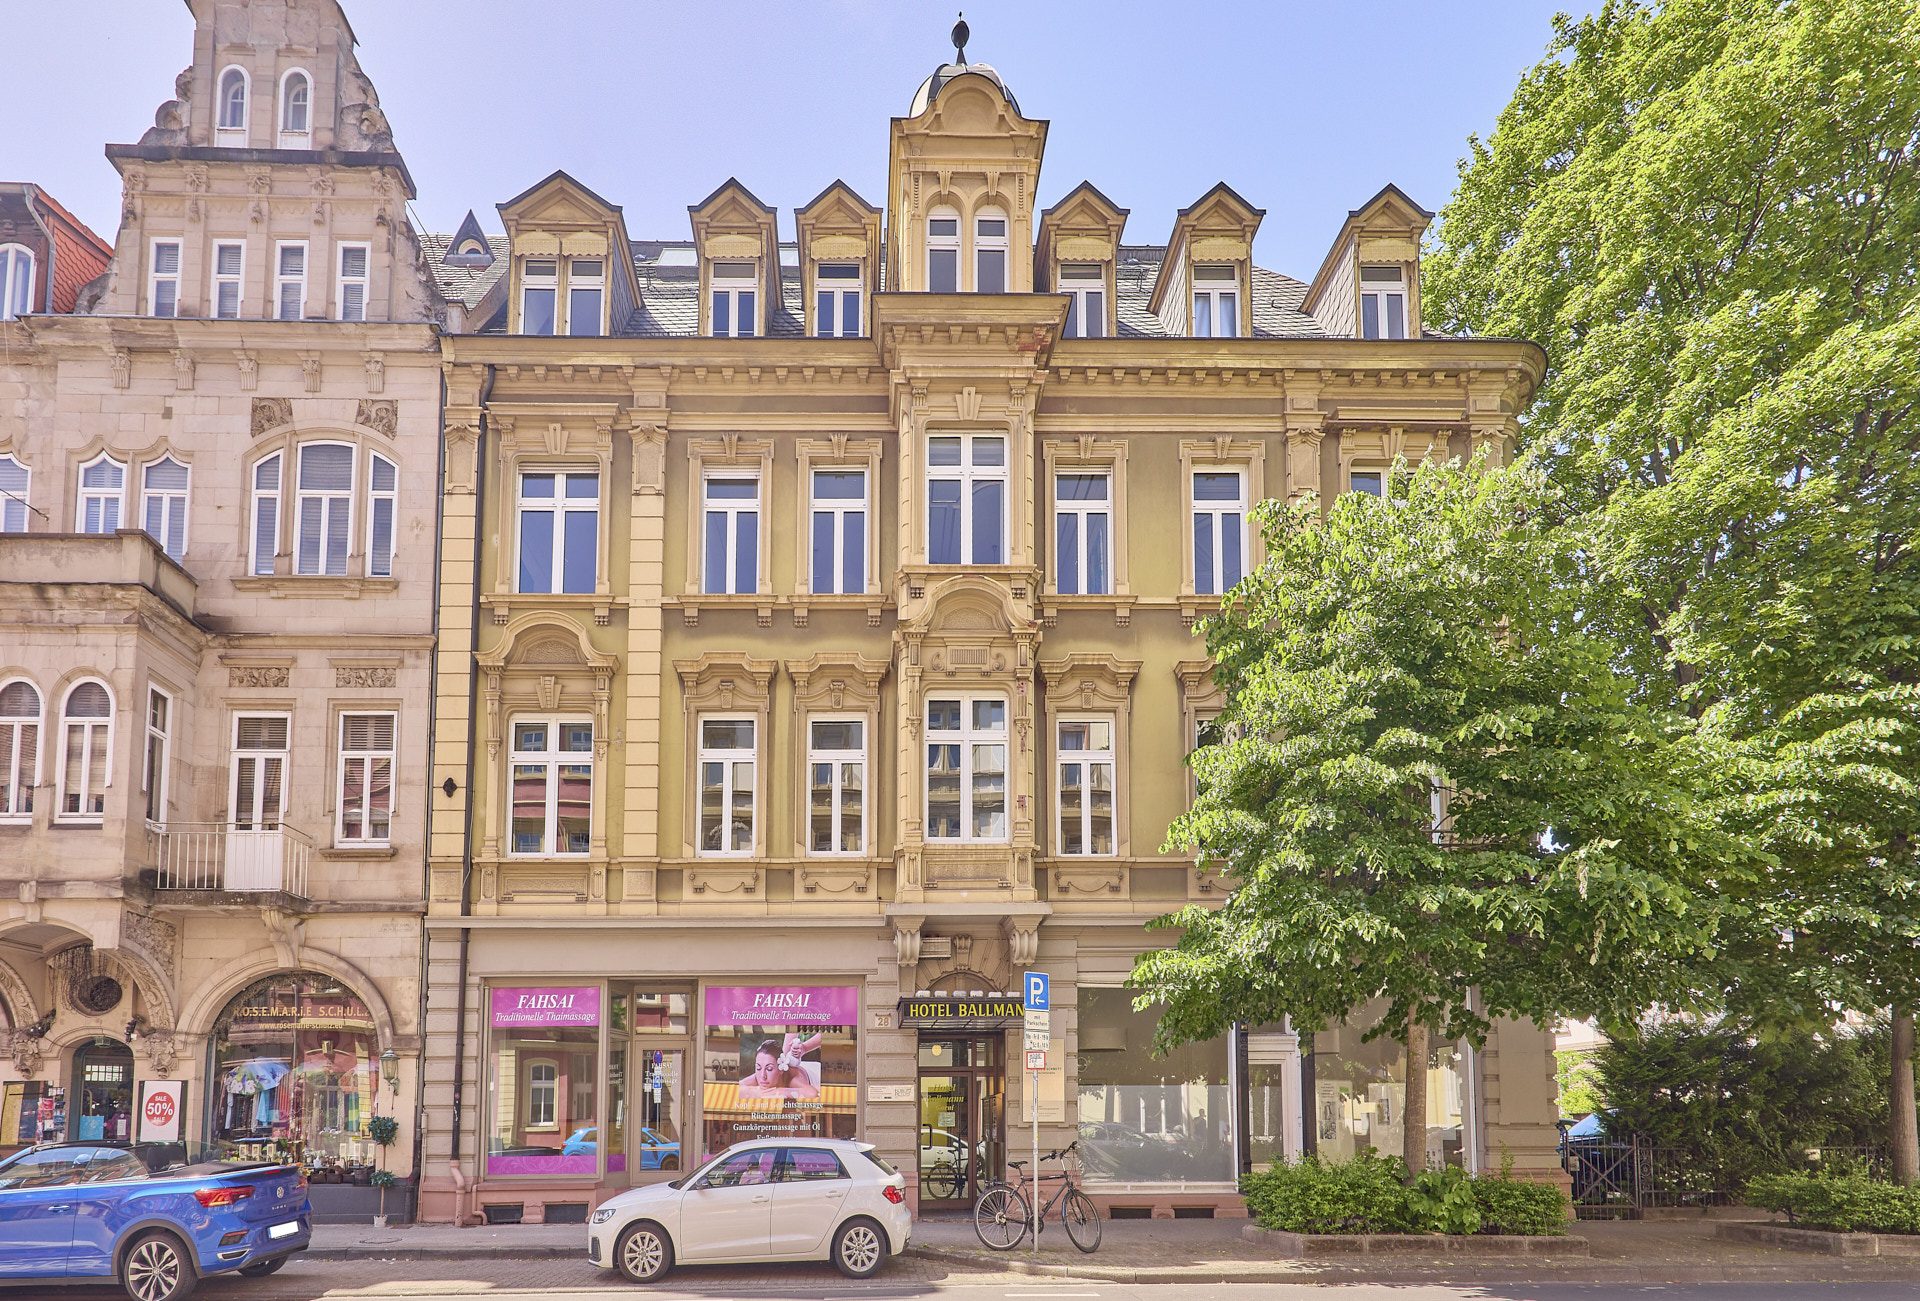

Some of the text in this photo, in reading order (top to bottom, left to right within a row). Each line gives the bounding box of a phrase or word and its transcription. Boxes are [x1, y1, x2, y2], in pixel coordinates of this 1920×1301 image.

[1031, 977, 1043, 1005] P
[517, 994, 575, 1009] FAHSAI
[753, 993, 810, 1008] FAHSAI
[731, 1010, 831, 1021] Traditionelle Thaimassage
[909, 1003, 1024, 1017] HOTEL BALLMAN
[495, 1011, 595, 1022] Traditionelle Thaimassage
[877, 1017, 889, 1027] 28
[924, 1094, 964, 1103] allmann
[147, 1103, 173, 1116] 50%
[752, 1112, 802, 1121] Rückenmassage
[733, 1122, 821, 1132] Ganzkörpermassage mit Öl
